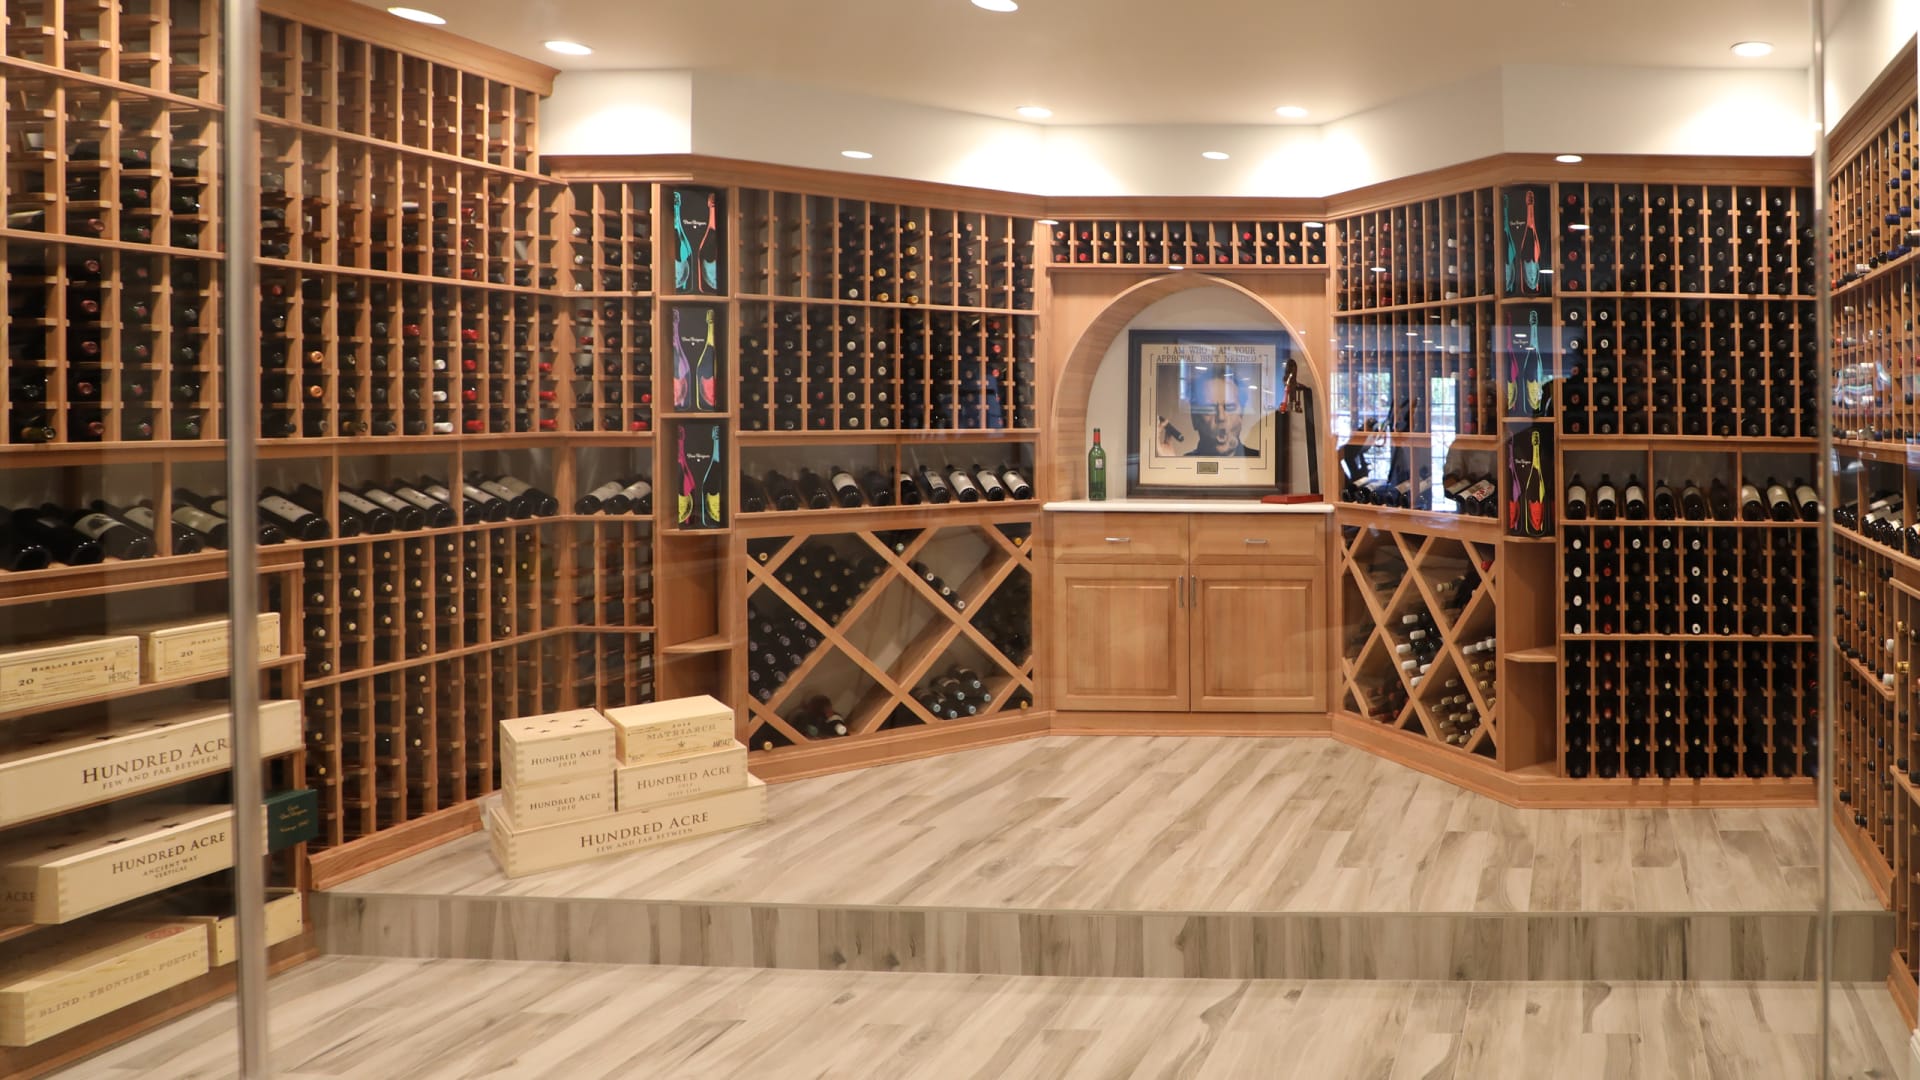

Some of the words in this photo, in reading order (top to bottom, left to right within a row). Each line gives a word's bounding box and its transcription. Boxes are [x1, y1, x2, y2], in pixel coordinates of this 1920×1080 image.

[18, 678, 34, 687] 20
[82, 750, 182, 784] HUNDRED
[190, 738, 231, 757] ACR
[531, 753, 577, 766] HUNDRED
[580, 748, 601, 758] ACRE
[102, 778, 123, 790] FEW
[128, 772, 150, 784] AND
[153, 767, 172, 777] FAR
[175, 754, 218, 771] BETWEEN
[637, 772, 698, 790] HUNDRED
[702, 765, 731, 778] ACRE
[530, 797, 576, 811] HUNDRED
[579, 792, 601, 802] ACRE
[580, 822, 663, 848] HUNDRED
[669, 811, 709, 829] ACRE
[112, 845, 185, 874] HUNDRED
[190, 832, 225, 851] ACRE
[596, 845, 612, 853] FEW
[617, 840, 635, 848] AND
[143, 860, 180, 876] ANCIENT
[39, 997, 80, 1017] BLIND
[89, 969, 150, 998] FRONTIER
[159, 950, 199, 970] POETIC
